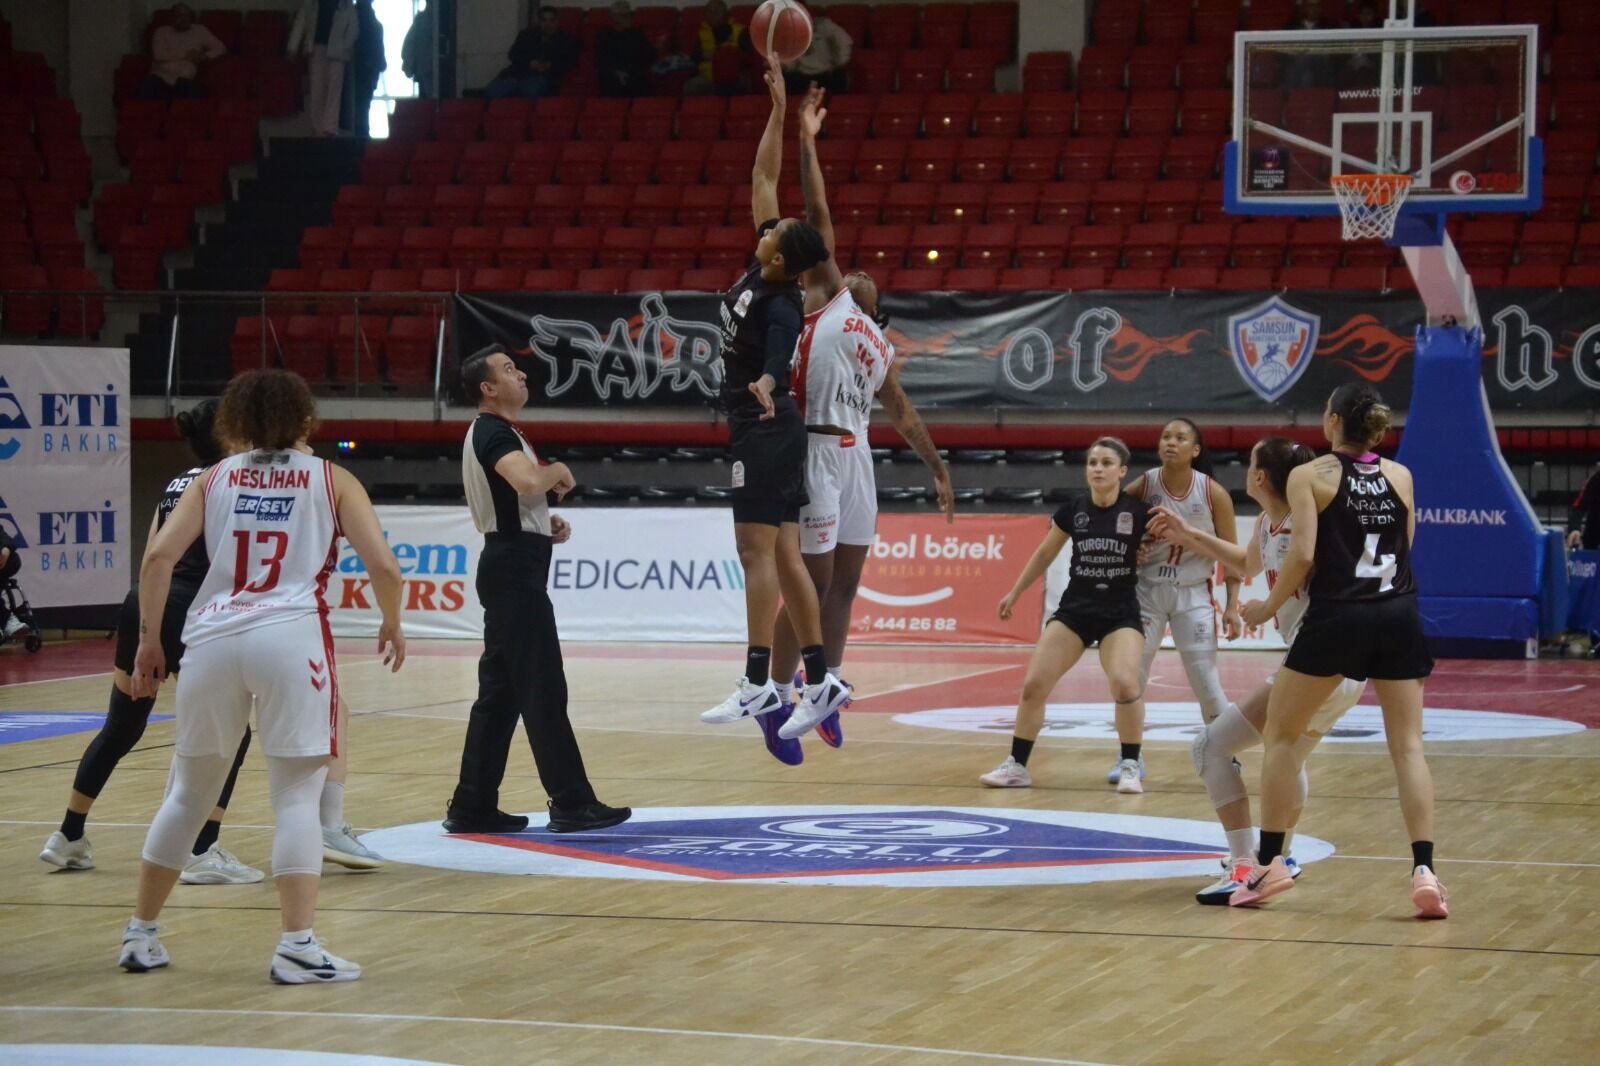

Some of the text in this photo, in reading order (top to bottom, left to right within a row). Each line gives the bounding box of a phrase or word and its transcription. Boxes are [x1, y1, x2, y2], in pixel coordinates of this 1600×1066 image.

[1252, 320, 1296, 334] SAMSUN
[1003, 306, 1122, 392] of
[39, 384, 120, 427] ETİ
[44, 433, 118, 452] BAKIR
[228, 466, 310, 489] NESLİHAN
[37, 500, 117, 546] ETİ
[1413, 507, 1507, 525] HALKBANK
[924, 534, 1004, 560] börek
[1077, 537, 1128, 555] TURGUTLU
[41, 550, 114, 571] BAKIR
[231, 530, 289, 597] 13
[1355, 533, 1398, 593] 4
[339, 578, 465, 611] KRS
[873, 617, 957, 631] 444 26 82
[642, 837, 1011, 858] ZORLU
